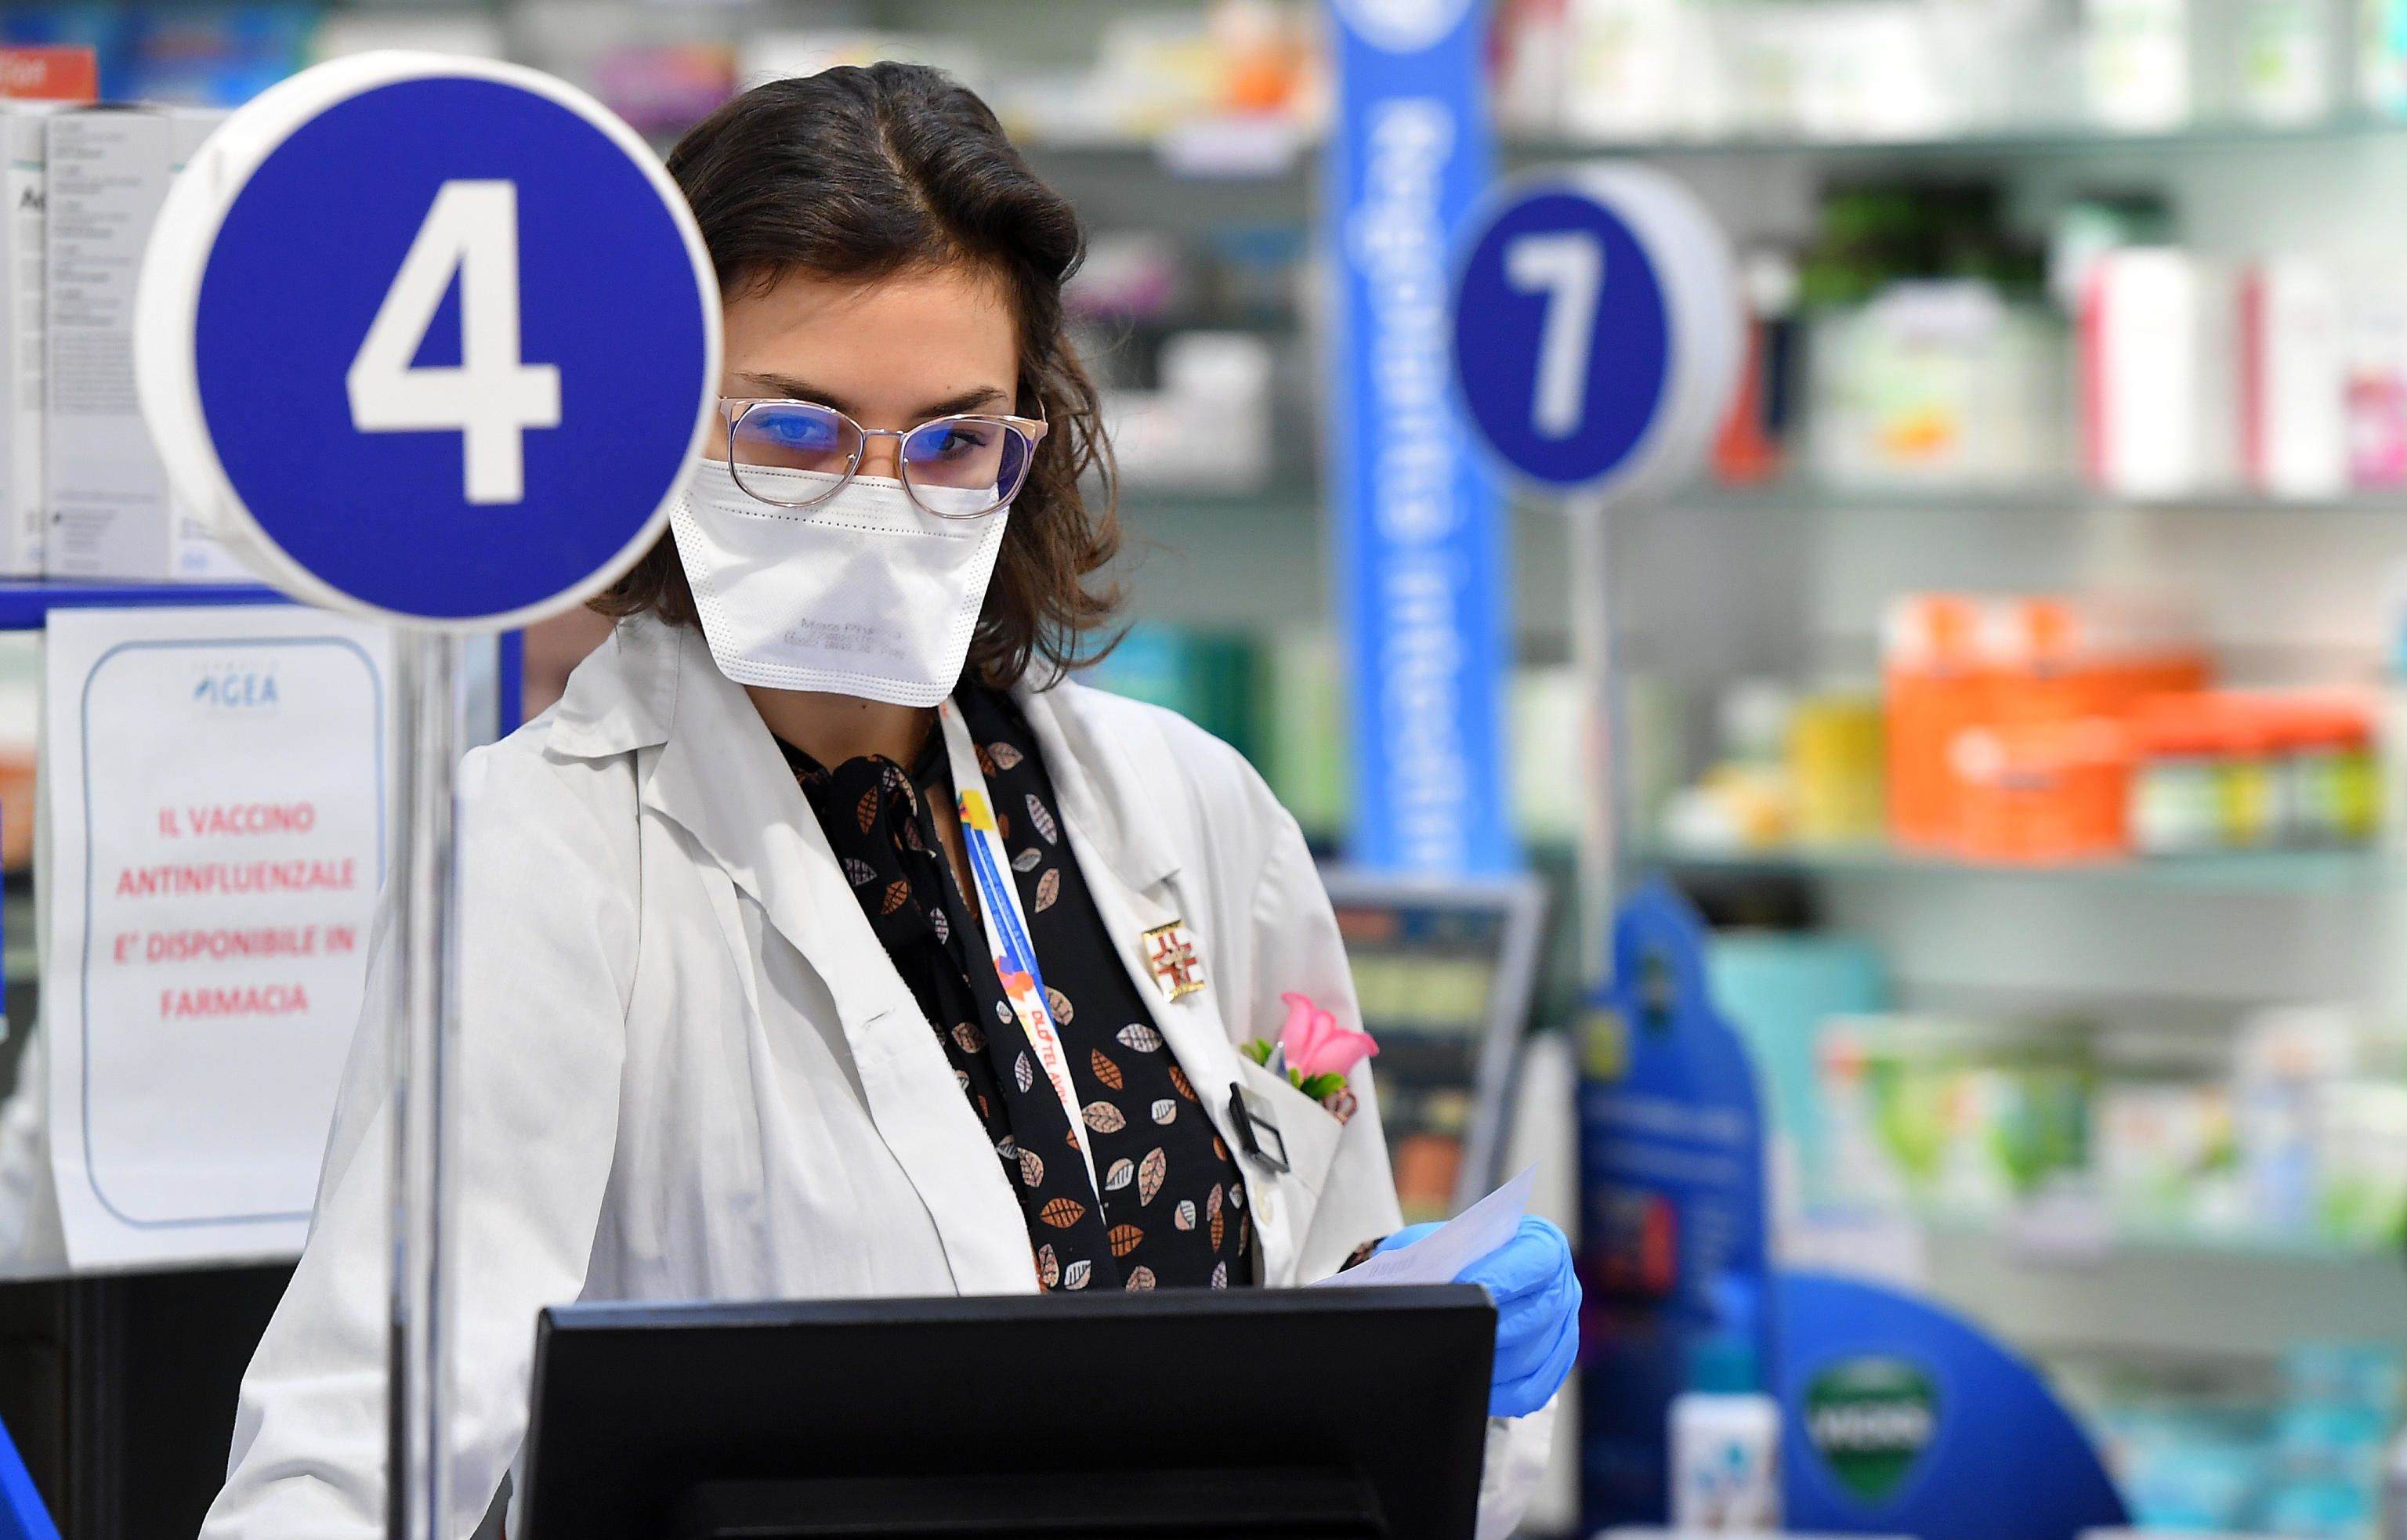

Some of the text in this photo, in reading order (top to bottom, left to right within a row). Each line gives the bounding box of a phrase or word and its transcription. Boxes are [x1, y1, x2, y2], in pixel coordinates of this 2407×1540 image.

[346, 179, 563, 505] 4
[1504, 231, 1605, 440] 7
[159, 801, 316, 838] IL VACCINO
[116, 857, 355, 895] ANTINFLUENZALE
[114, 925, 355, 963] E' DISPONIBILE IN
[160, 984, 309, 1020] FARMACIA
[1042, 1046, 1057, 1068] TEL
